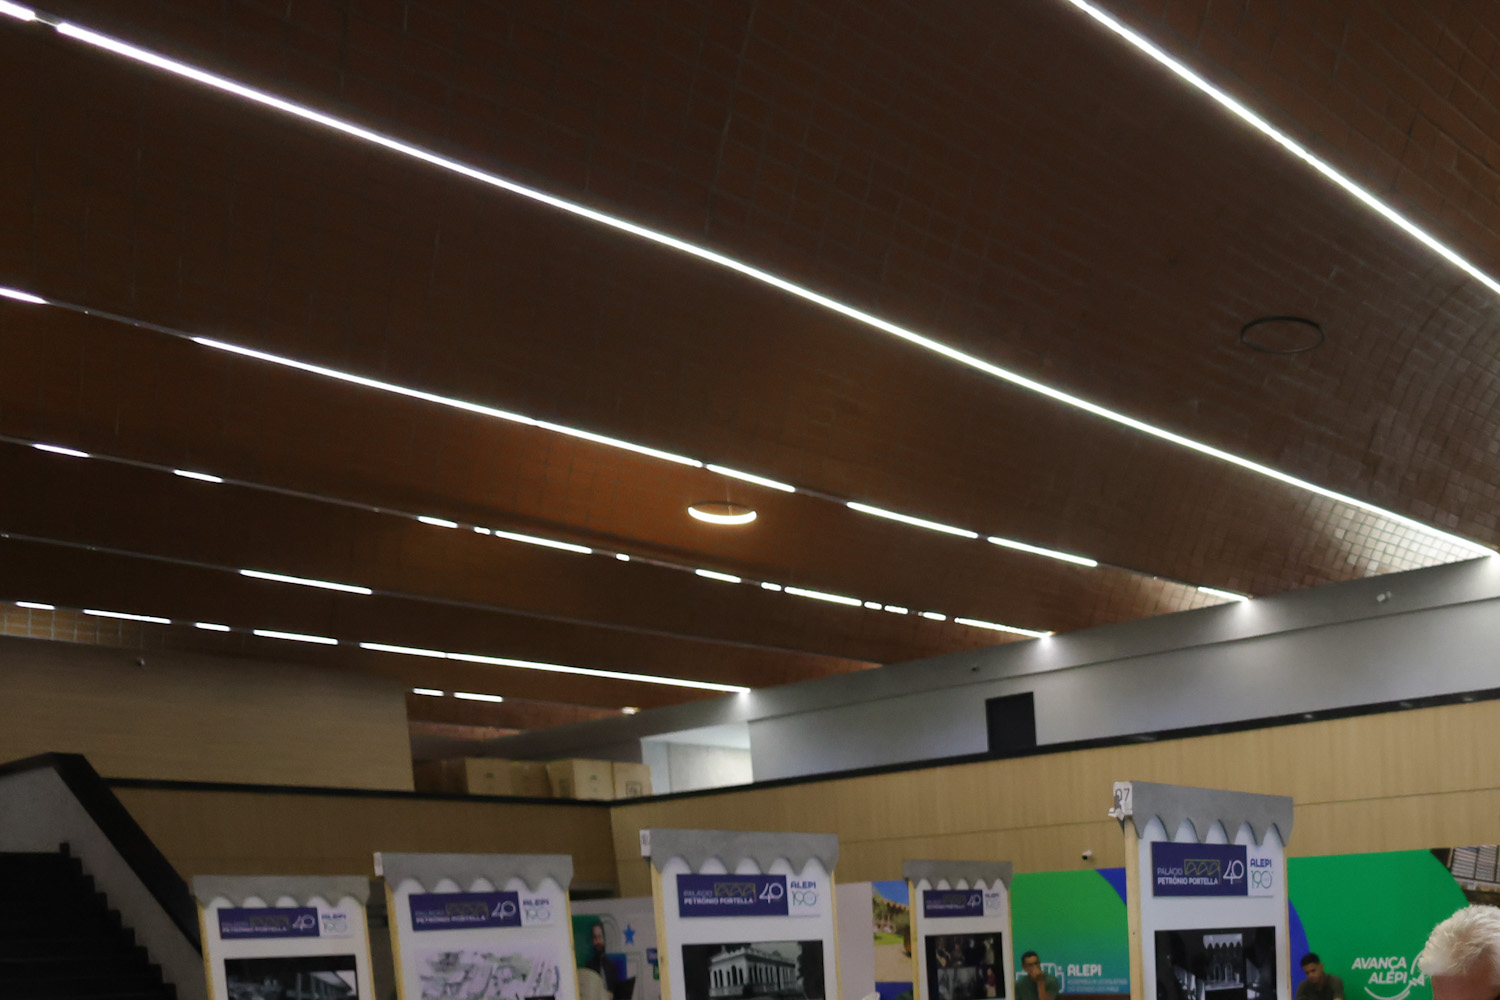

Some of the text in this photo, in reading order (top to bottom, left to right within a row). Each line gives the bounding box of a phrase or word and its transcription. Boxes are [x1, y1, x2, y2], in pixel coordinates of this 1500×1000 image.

[1250, 858, 1272, 867] ALEPI
[1157, 867, 1183, 876] PALÁCIO
[1223, 860, 1244, 884] 40
[790, 881, 816, 889] ALEPI
[1158, 875, 1218, 885] PETRÔNIO PORTELLA
[759, 882, 784, 904] 40
[491, 900, 516, 919] 40
[292, 914, 316, 931] 40
[1352, 957, 1407, 970] AVANÇA
[1067, 964, 1102, 976] ALEPI
